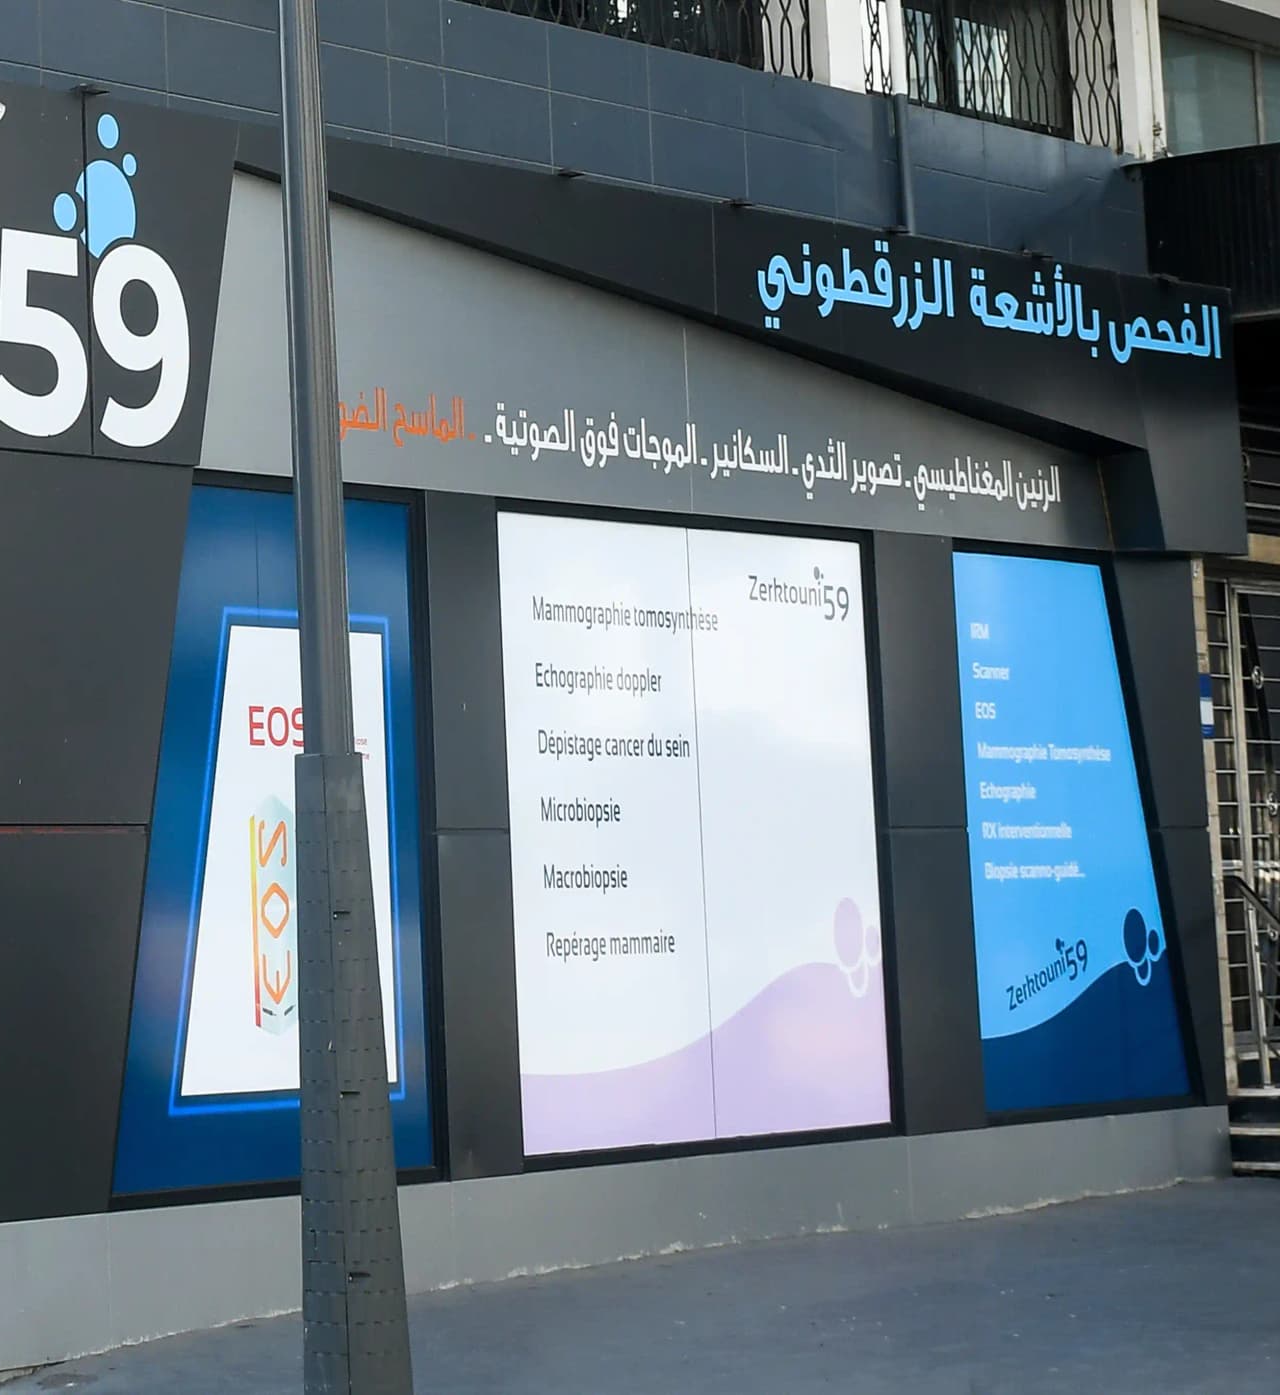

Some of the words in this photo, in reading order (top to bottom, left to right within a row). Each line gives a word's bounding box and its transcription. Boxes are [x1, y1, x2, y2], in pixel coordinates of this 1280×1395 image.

[757, 240, 954, 330] الزرقطوني
[968, 262, 1102, 362] بالأشعة
[1107, 304, 1221, 363] الفحص
[495, 402, 576, 462] الصوتية
[580, 412, 620, 467] فوق
[623, 417, 698, 475] الموجات
[710, 428, 789, 479] السكانير
[801, 437, 848, 499] الثدي
[850, 453, 903, 496] تصوير
[914, 456, 1013, 511] المغناطيسي
[1015, 465, 1061, 512] الرنين
[532, 596, 632, 631] Mammographie
[634, 605, 719, 635] tomosynthèse
[535, 663, 614, 696] Echographie
[616, 667, 663, 697] doppler
[972, 662, 1010, 680] Scanner
[975, 702, 996, 719] EOS
[538, 729, 602, 762] Dépistage
[605, 738, 644, 758] cancer
[647, 734, 663, 757] du
[665, 736, 690, 758] sein
[977, 742, 1048, 763] Mammographie
[979, 781, 1036, 803] Echographie
[540, 796, 621, 828] Microbiopsie
[998, 822, 1072, 839] interventionnelle
[543, 864, 628, 895] Macrobiopsie
[984, 861, 1018, 882] Biopsie
[546, 931, 606, 963] Repérage
[610, 929, 675, 957] mammaire
